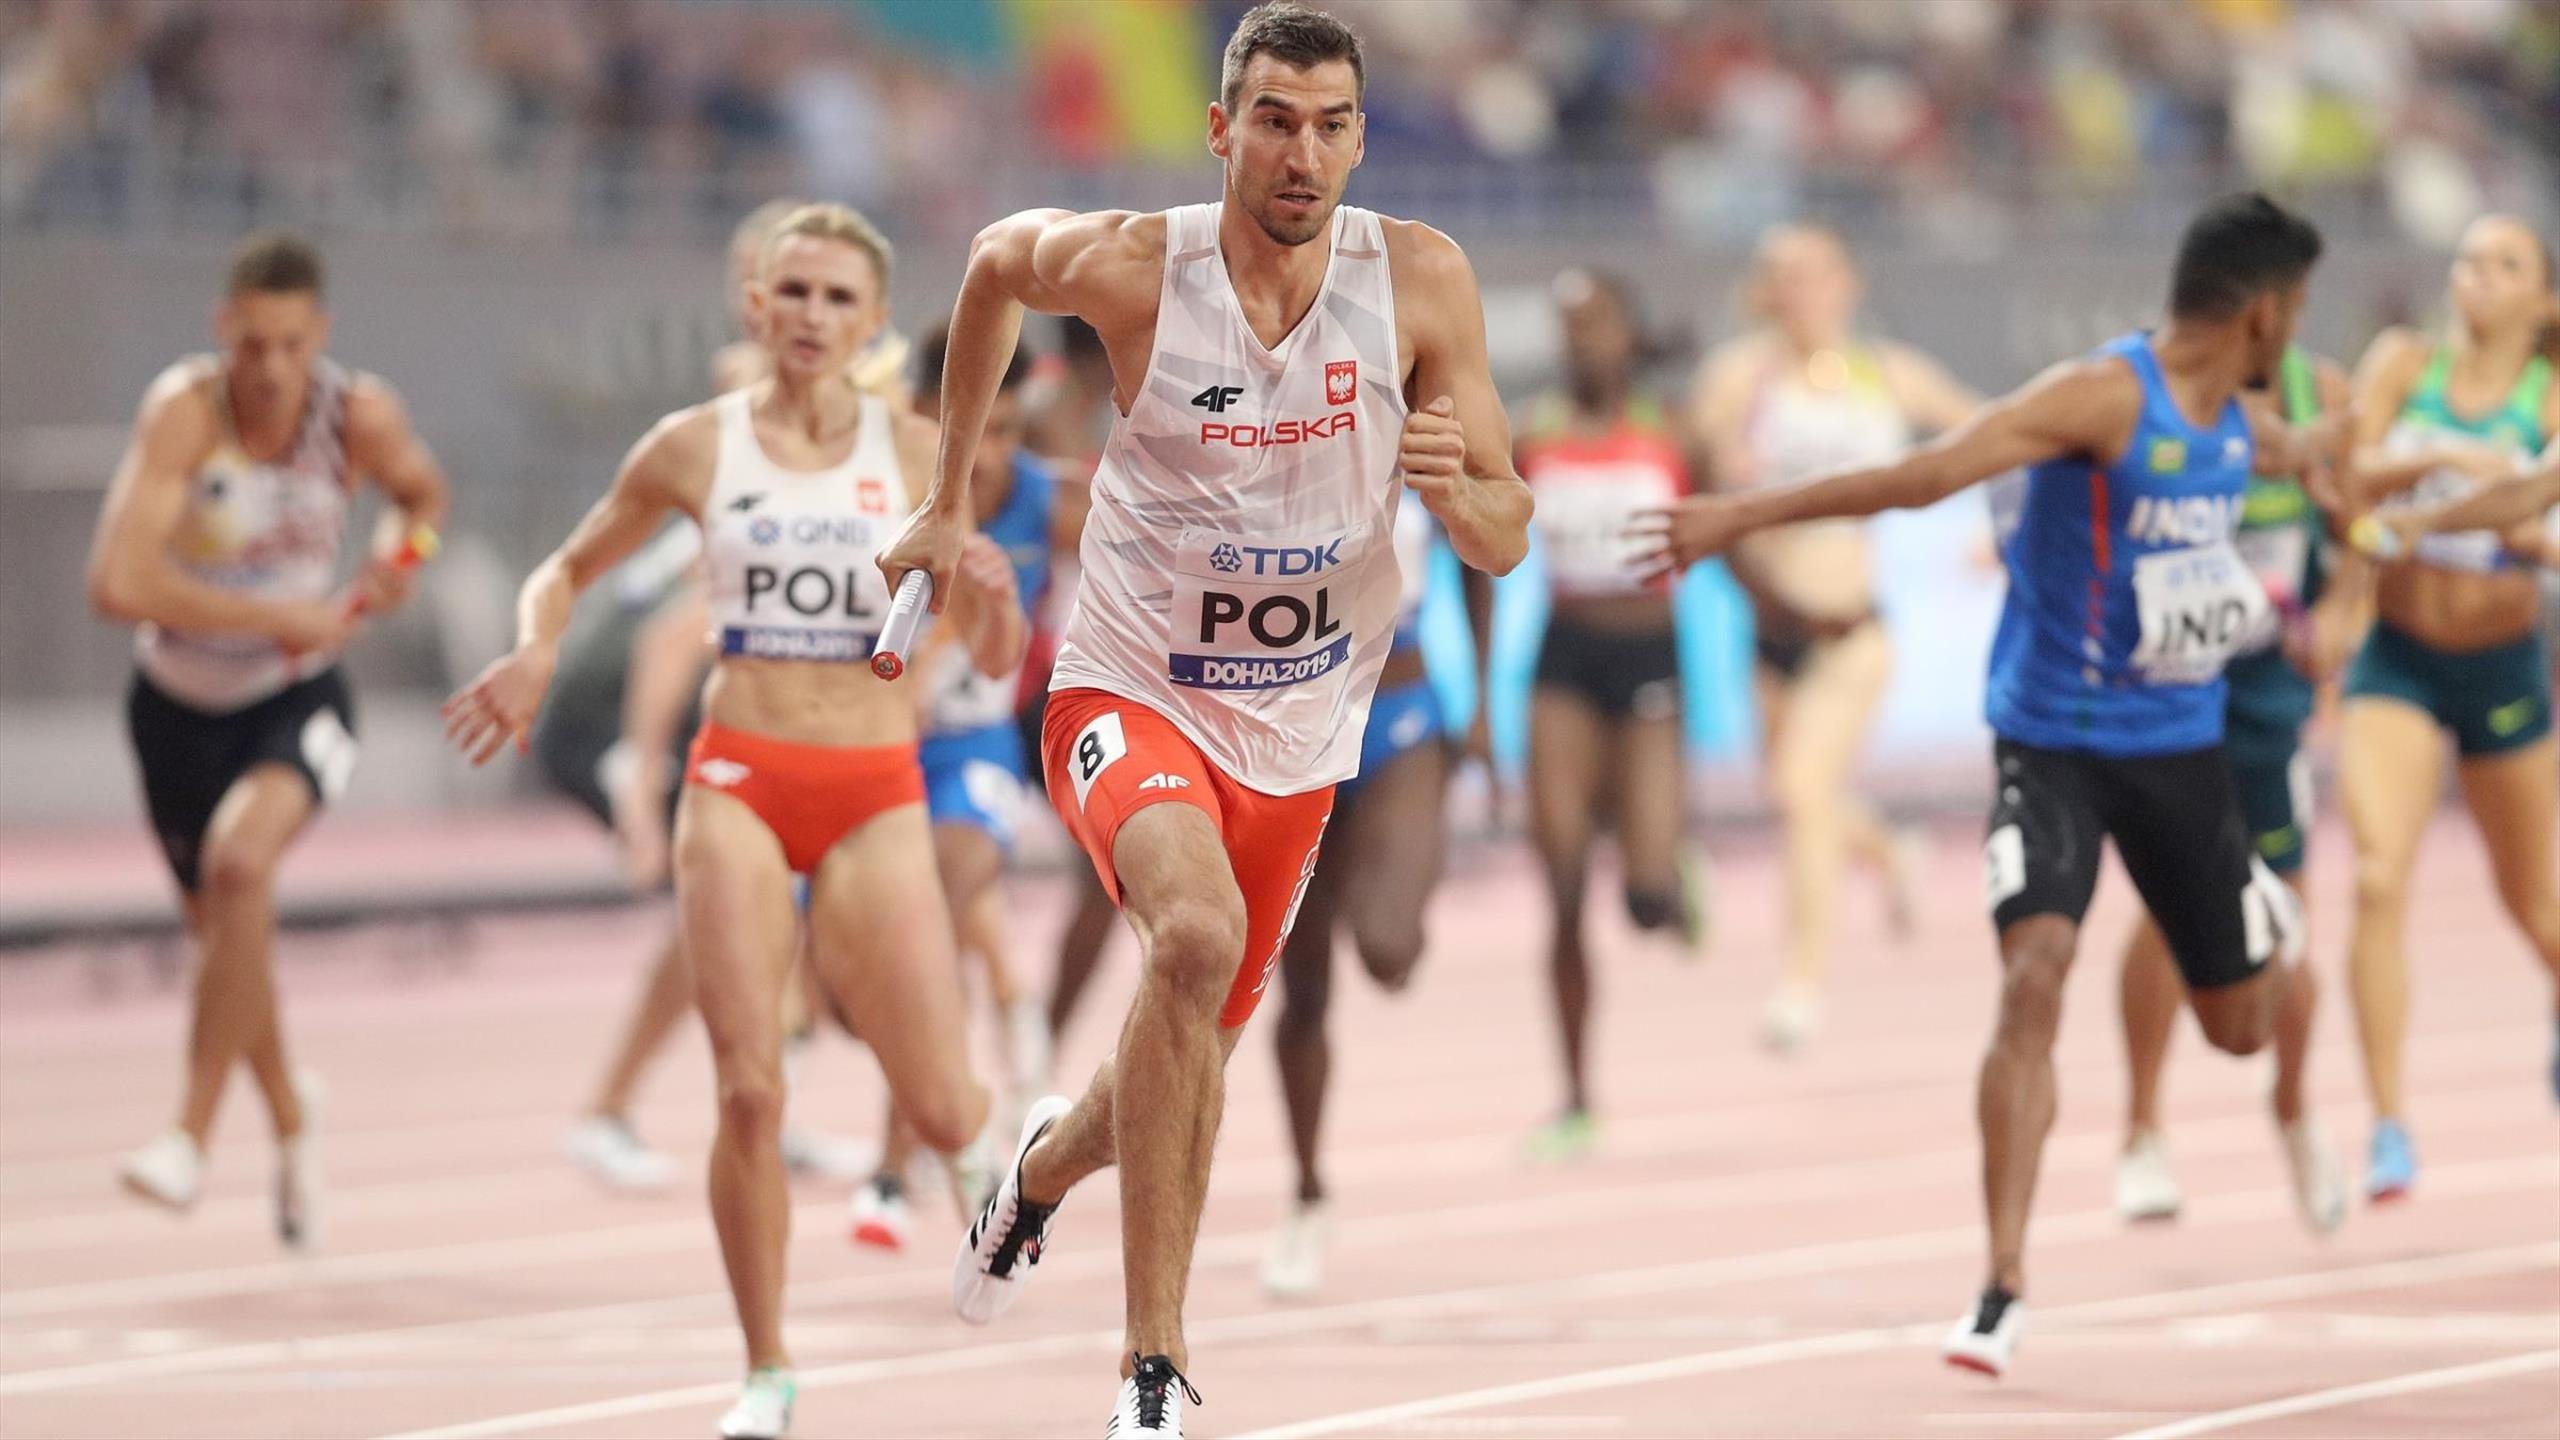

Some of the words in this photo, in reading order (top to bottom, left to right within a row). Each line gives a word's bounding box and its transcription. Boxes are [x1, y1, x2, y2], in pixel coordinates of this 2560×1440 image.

[1191, 385, 1245, 413] 4F
[1200, 412, 1356, 448] POLSKA
[1243, 537, 1346, 577] TDK
[746, 565, 872, 617] POL
[1200, 587, 1341, 649] POL
[2160, 596, 2247, 654] IND
[1203, 650, 1331, 686] DOHA2019
[1078, 730, 1106, 782] 8
